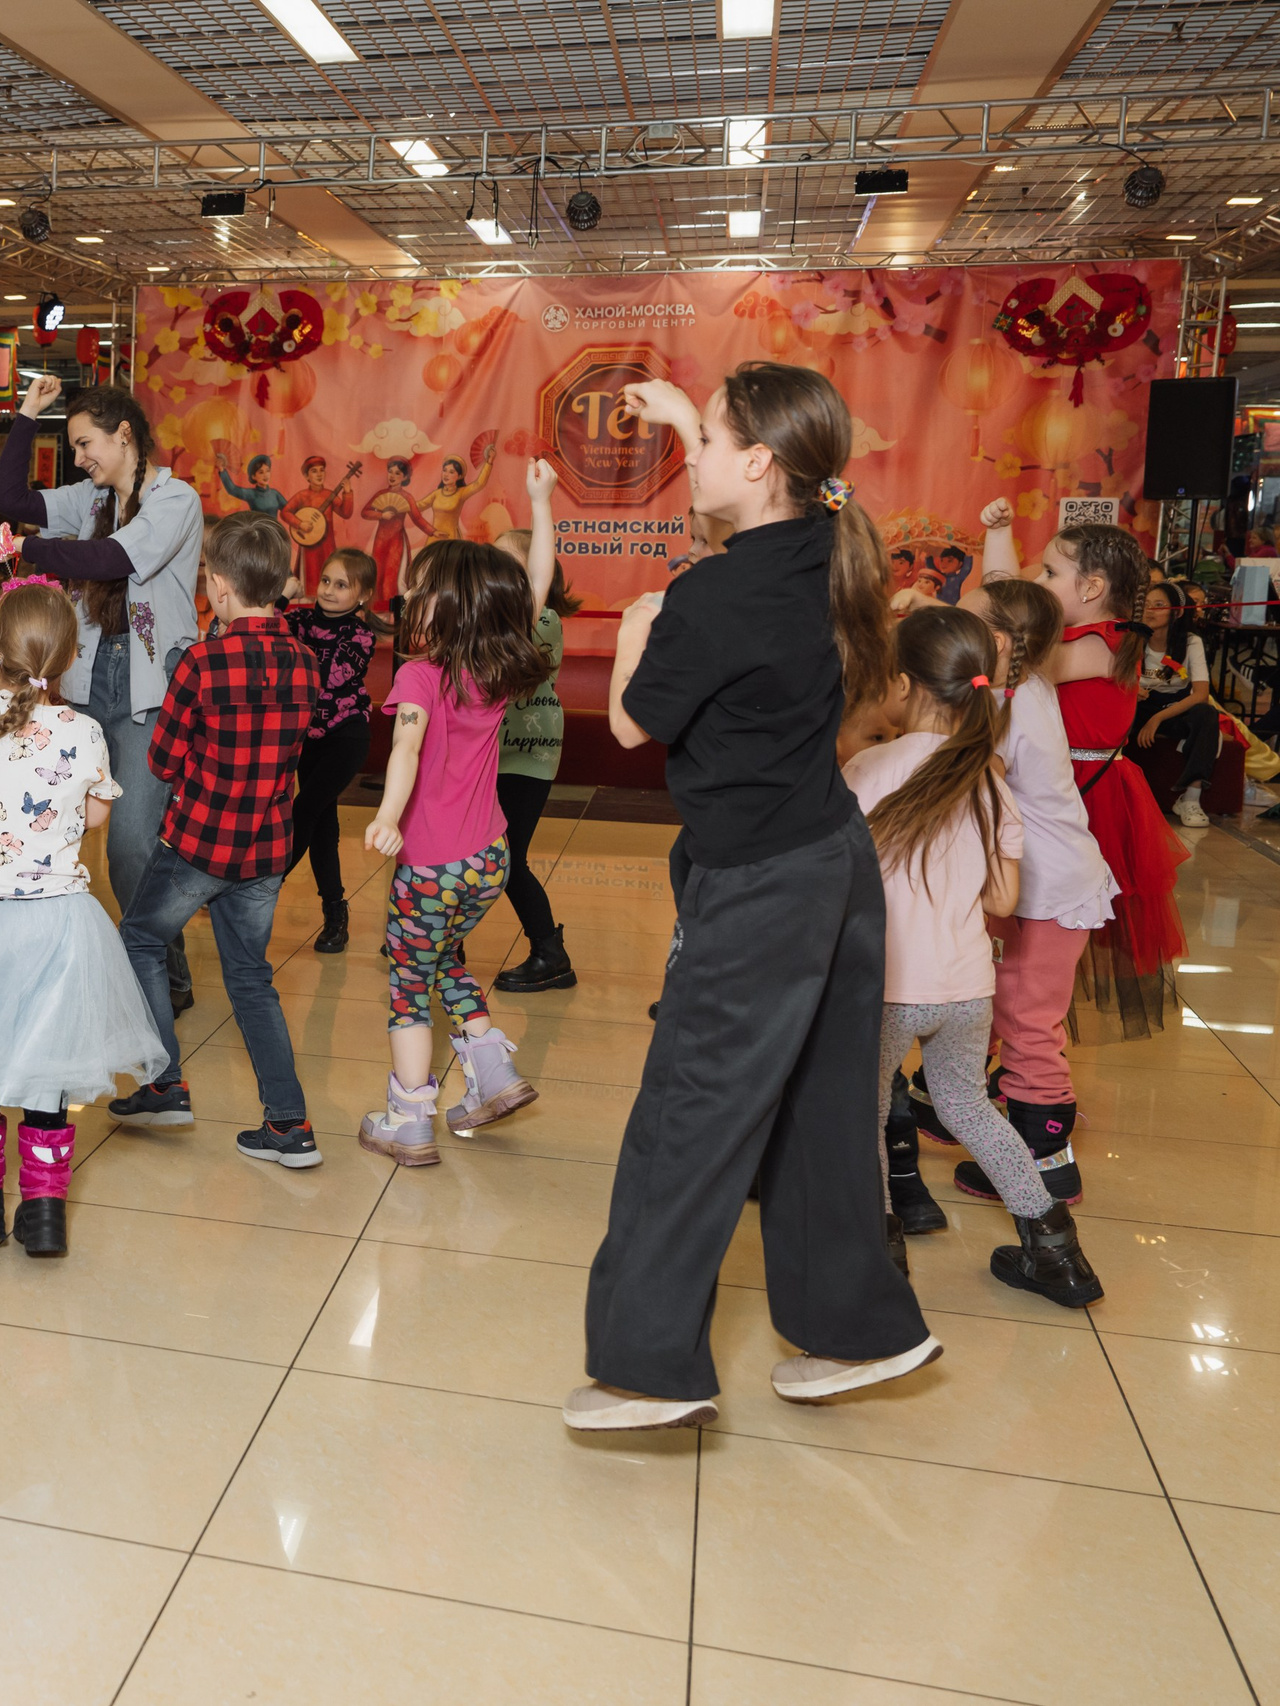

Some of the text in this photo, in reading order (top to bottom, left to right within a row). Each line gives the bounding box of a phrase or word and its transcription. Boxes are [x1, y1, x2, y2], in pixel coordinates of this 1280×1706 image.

[575, 303, 696, 319] ХАНОЙ-МОСКВА
[574, 318, 696, 330] ТОРГОВЫЙ ЦЕНТР
[580, 443, 646, 455] Vietnamese
[585, 456, 641, 471] New Year
[629, 541, 668, 558] год
[338, 642, 366, 669] CUTE
